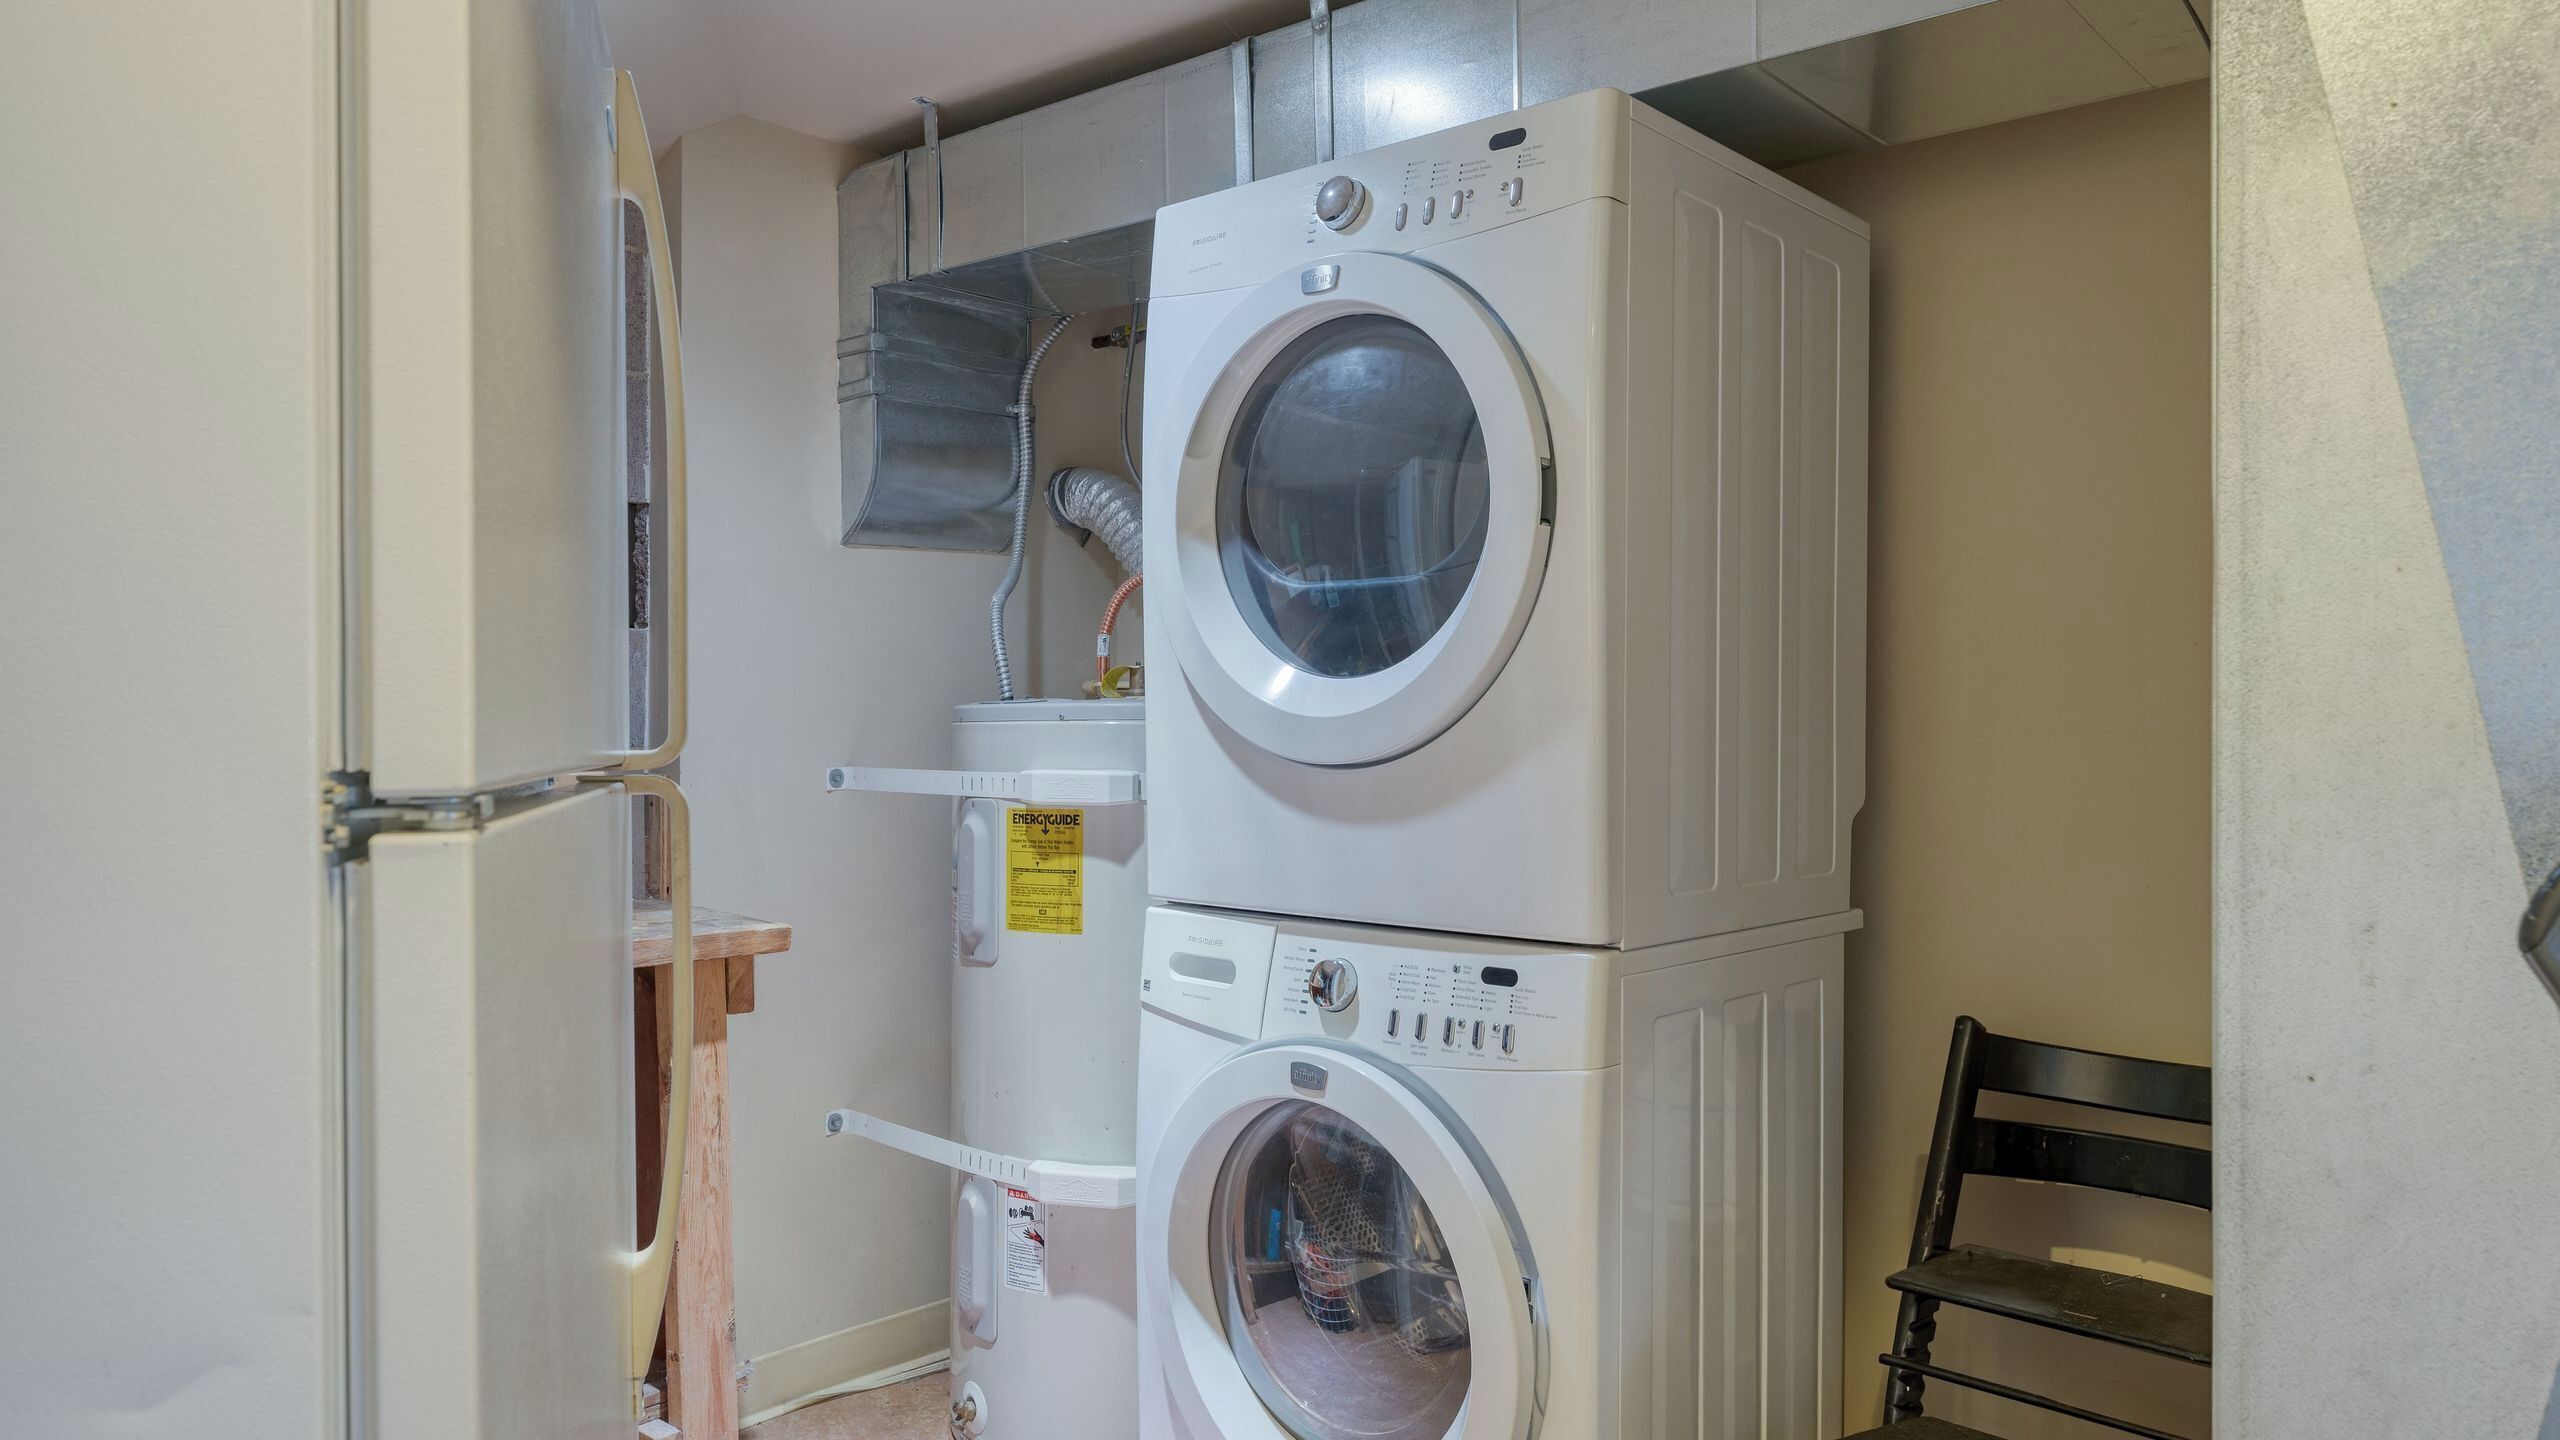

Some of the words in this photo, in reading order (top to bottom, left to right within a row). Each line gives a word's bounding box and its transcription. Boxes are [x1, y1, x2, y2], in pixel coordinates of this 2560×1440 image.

[1192, 232, 1227, 246] FRIGIDAIRE
[1304, 274, 1334, 287] affinity
[1012, 813, 1080, 826] ENERGYGUIDE
[1188, 936, 1224, 947] FRIGIDAIRE
